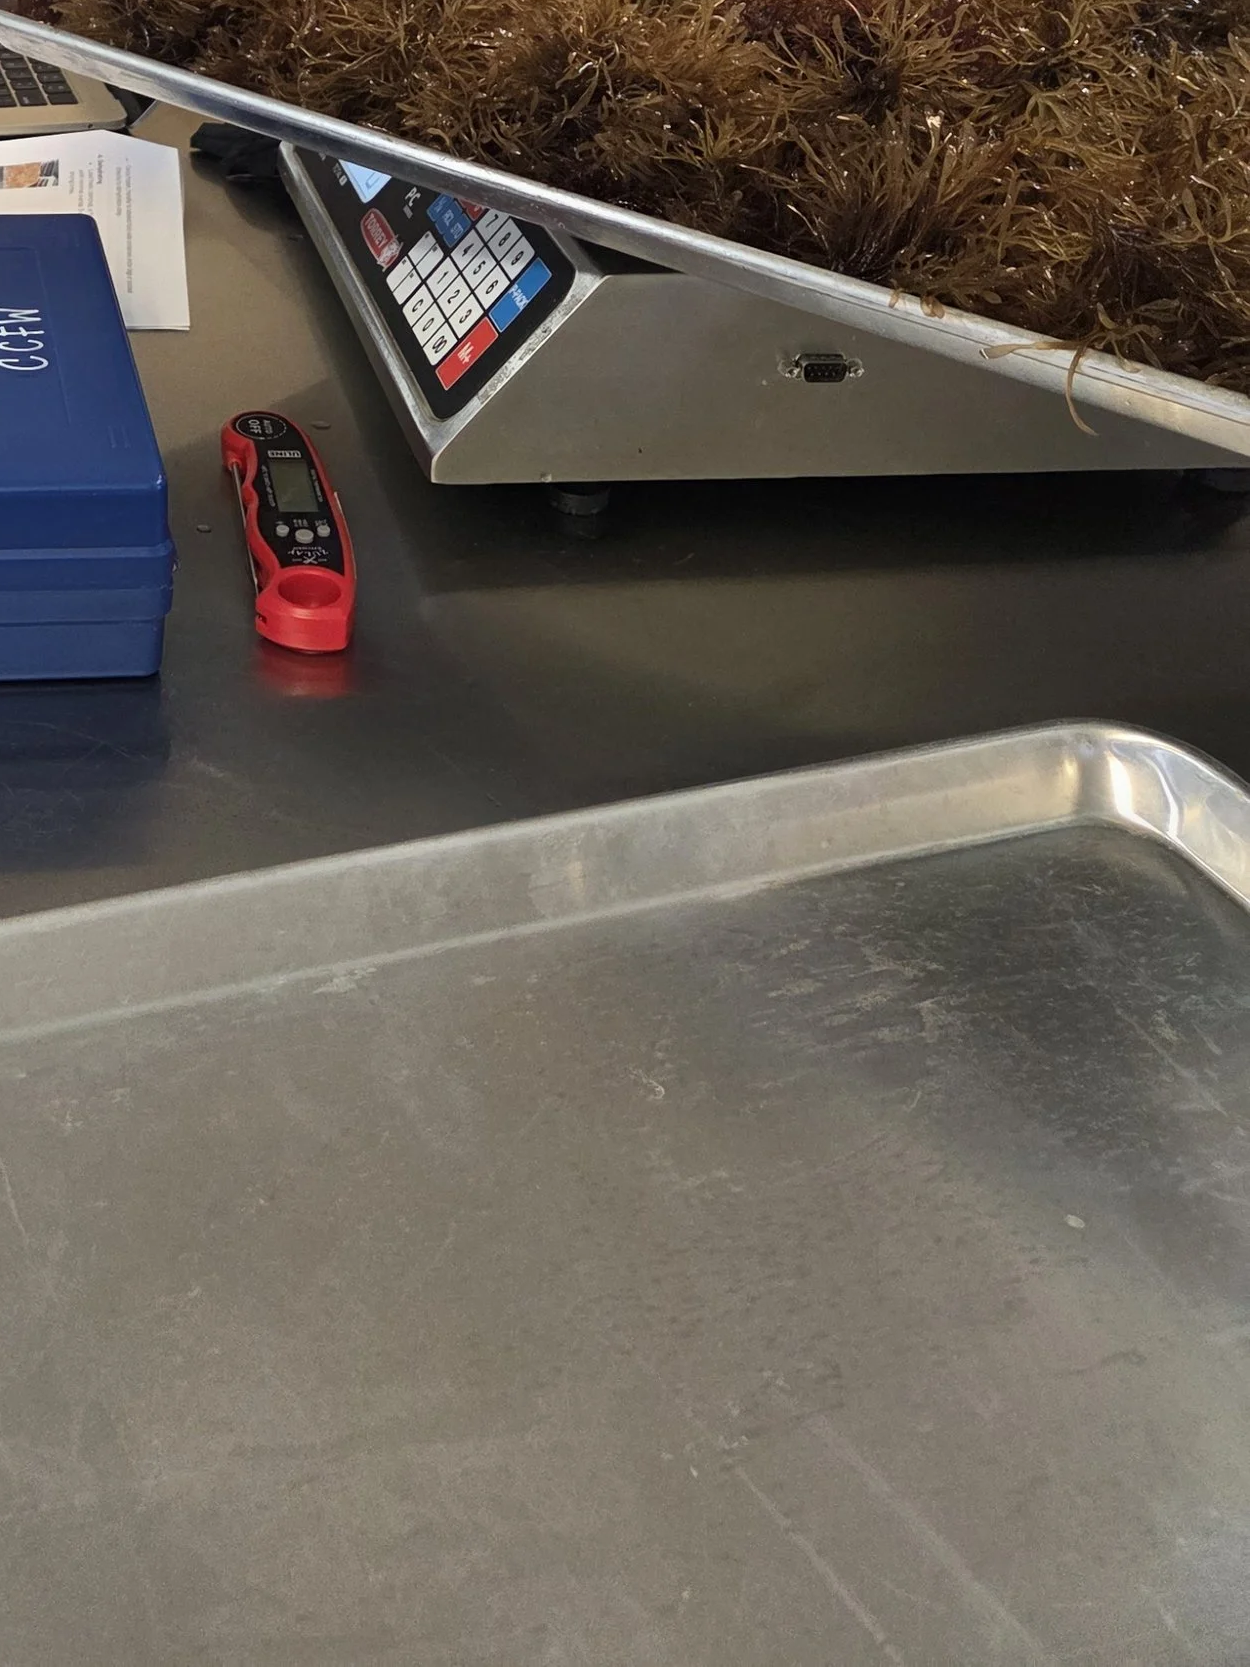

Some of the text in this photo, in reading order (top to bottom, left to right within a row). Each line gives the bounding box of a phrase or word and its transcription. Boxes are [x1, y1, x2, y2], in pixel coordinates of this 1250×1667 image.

[404, 187, 421, 207] PC
[485, 213, 499, 228] 7
[498, 232, 512, 247] 8
[461, 242, 475, 257] 4
[510, 250, 525, 266] 9
[472, 260, 486, 276] 5
[436, 270, 449, 285] 1
[485, 279, 499, 295] 6
[447, 289, 461, 304] 2
[411, 298, 424, 313] C
[458, 308, 472, 325] 3
[422, 317, 435, 332] 0
[248, 419, 262, 434] OFF
